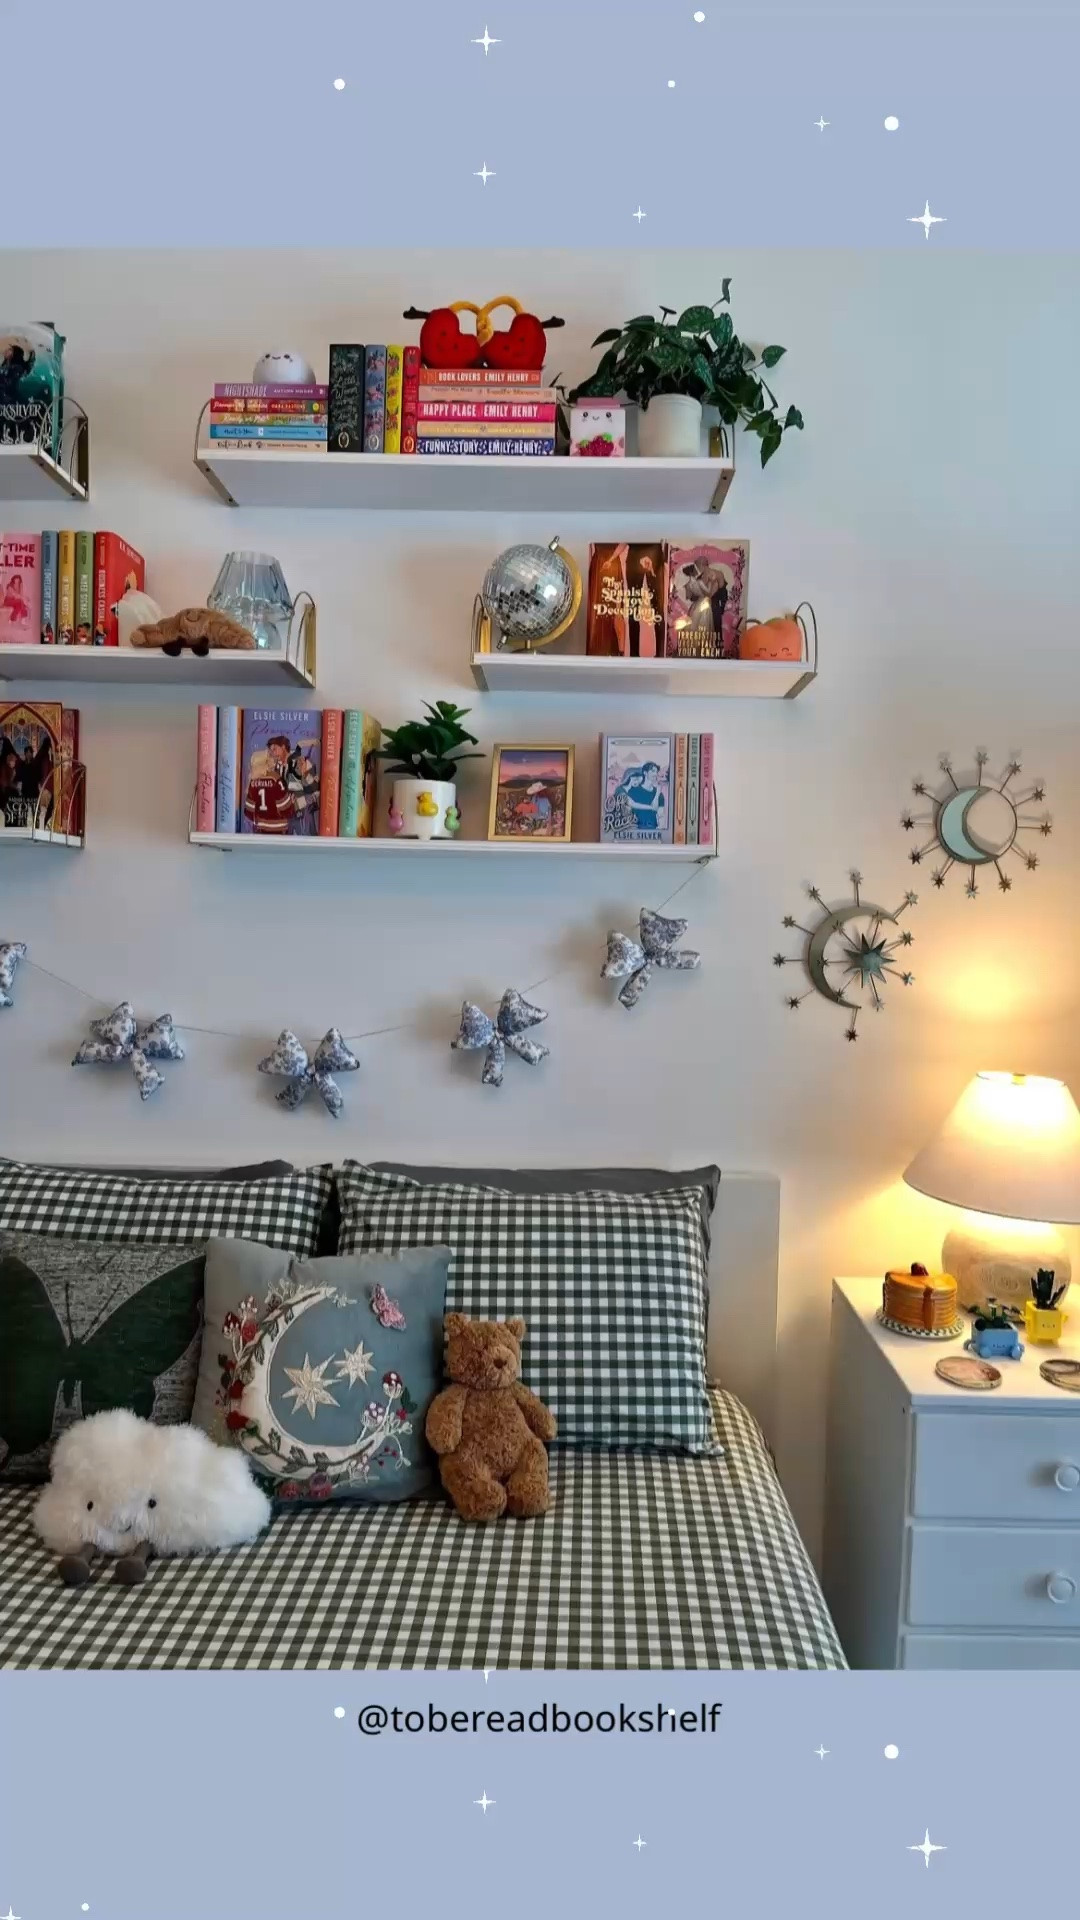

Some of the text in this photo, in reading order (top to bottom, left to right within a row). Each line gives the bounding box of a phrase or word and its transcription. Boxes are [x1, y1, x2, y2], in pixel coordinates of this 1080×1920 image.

[439, 373, 528, 382] BOOK LOVERS EMILY HENRY
[224, 384, 267, 397] NIGHTSHADE
[423, 404, 538, 417] HAPPY PLACE EMILY HENRY
[425, 441, 539, 454] FUNNY STORY EMILY HENRY
[700, 647, 725, 657] ENEMY
[254, 711, 309, 721] ELSIE SILVER
[258, 788, 268, 811] 1
